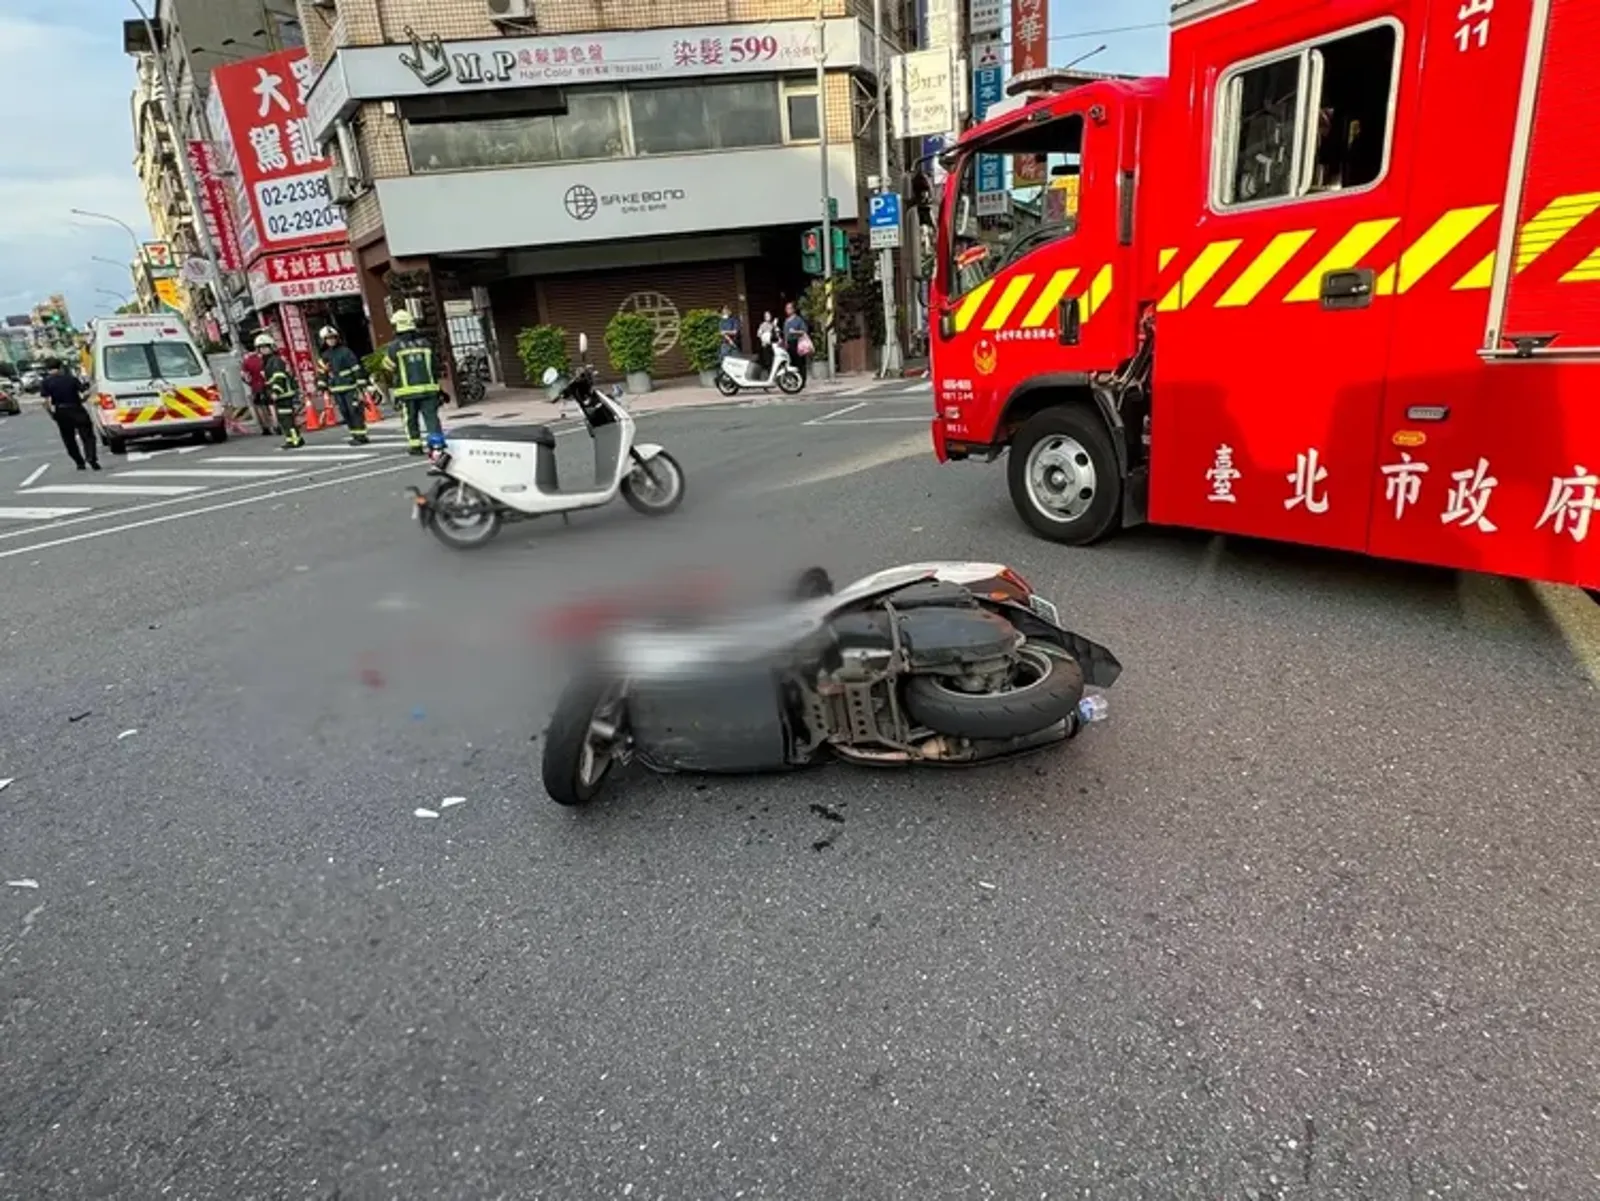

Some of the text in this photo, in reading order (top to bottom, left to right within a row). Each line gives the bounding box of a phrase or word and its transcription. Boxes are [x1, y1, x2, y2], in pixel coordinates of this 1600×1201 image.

[673, 38, 724, 66] 染髮
[729, 35, 777, 62] 599
[1453, 18, 1490, 52] 11
[452, 50, 516, 84] M.P
[249, 116, 325, 173] 駕訓
[261, 178, 328, 206] 02-2338
[870, 197, 885, 216] P
[1205, 443, 1600, 543] 臺北市政府
